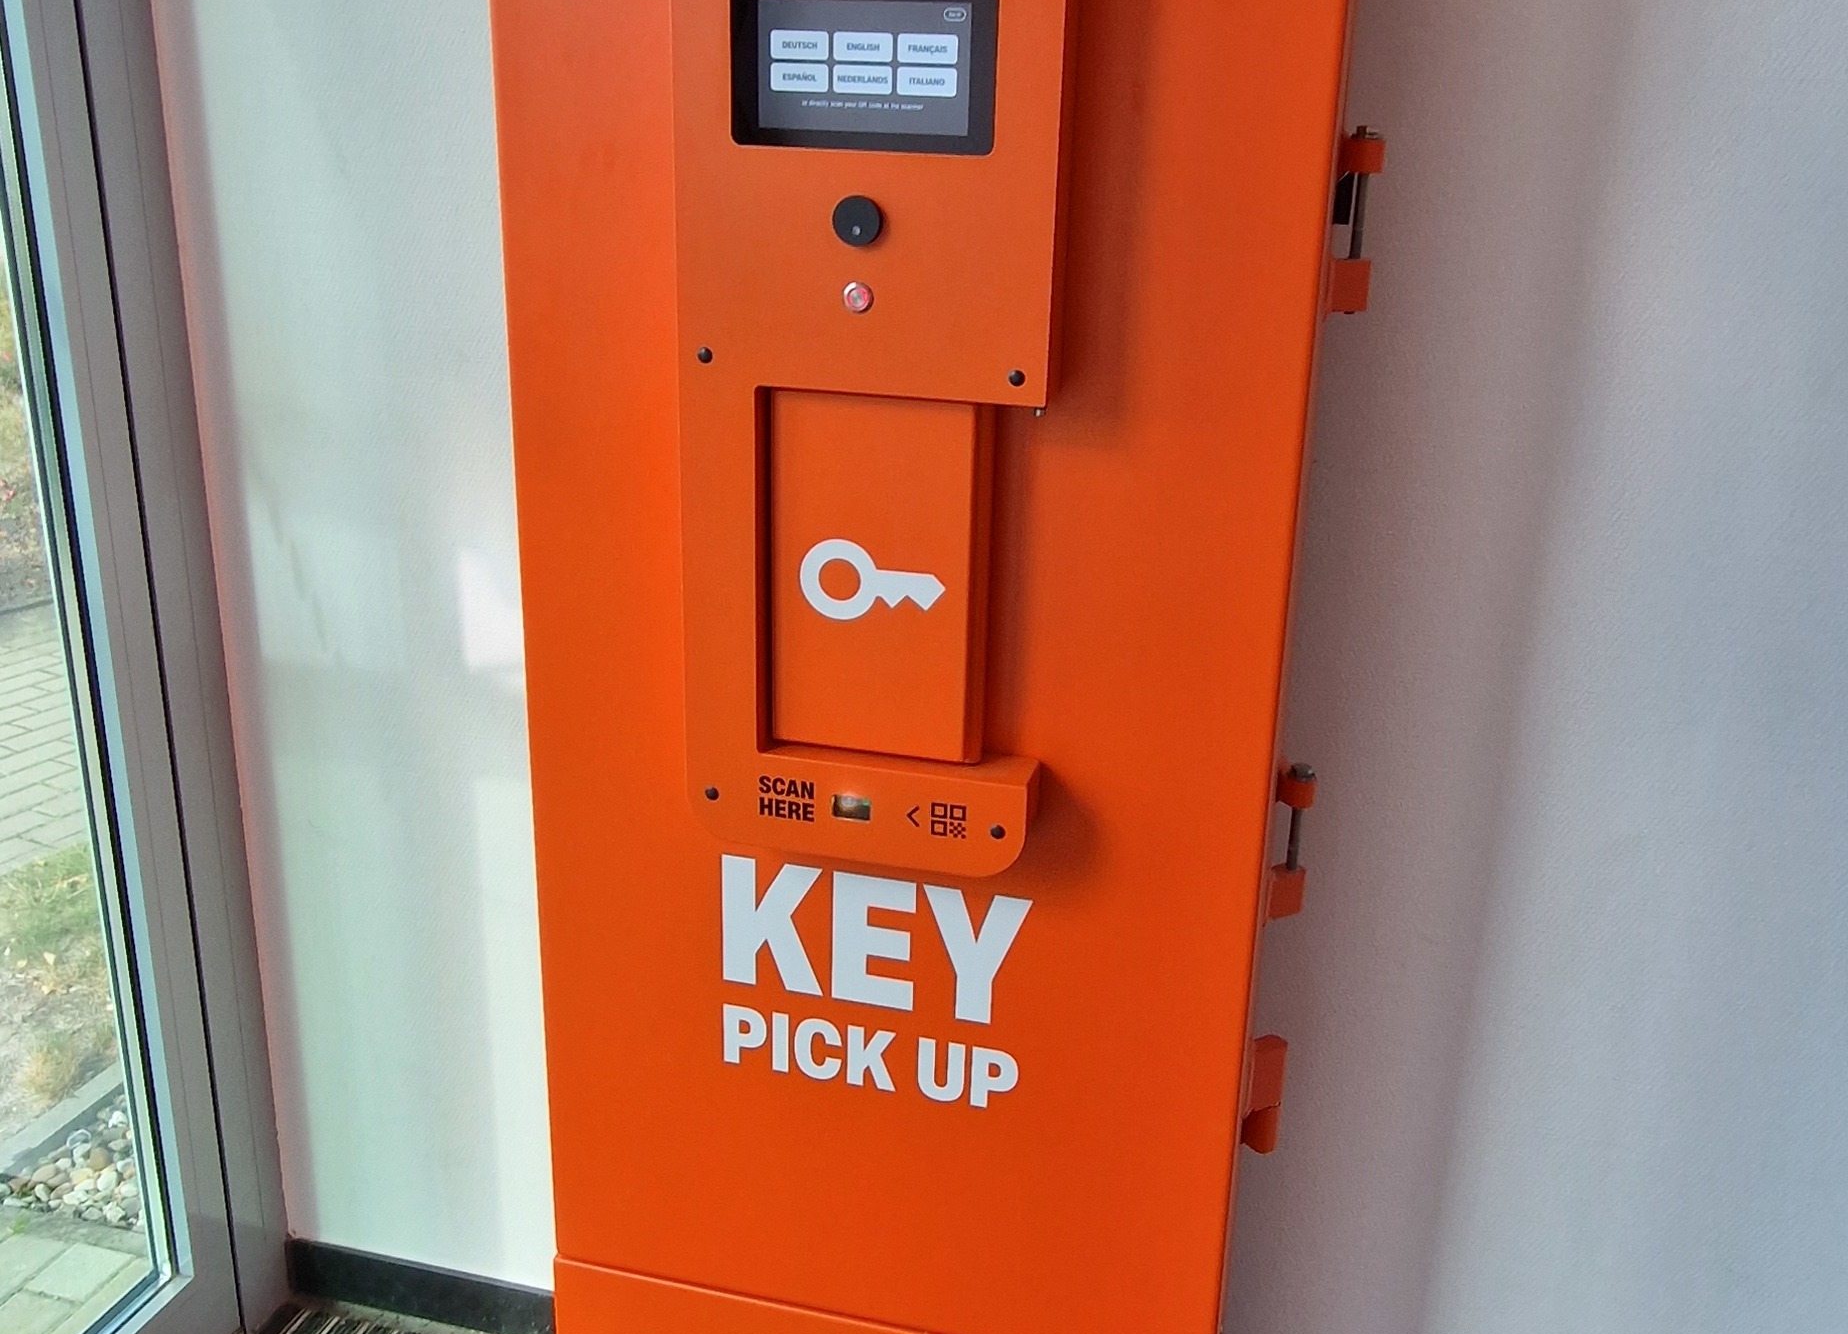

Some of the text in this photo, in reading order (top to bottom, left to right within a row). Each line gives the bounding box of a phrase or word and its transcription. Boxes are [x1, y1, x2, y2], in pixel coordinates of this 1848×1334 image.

[781, 40, 818, 50] DEUTSCH
[846, 42, 880, 52] ENGLISH
[907, 44, 948, 55] FRANÇAIS
[782, 72, 817, 82] ESPAÑOL
[837, 74, 888, 84] NEDERLANDS
[908, 77, 946, 86] ITALIANO
[758, 775, 815, 800] SCAN
[758, 797, 815, 822] HERE
[721, 853, 1034, 1025] KEY
[722, 1003, 1019, 1108] PICK UP
